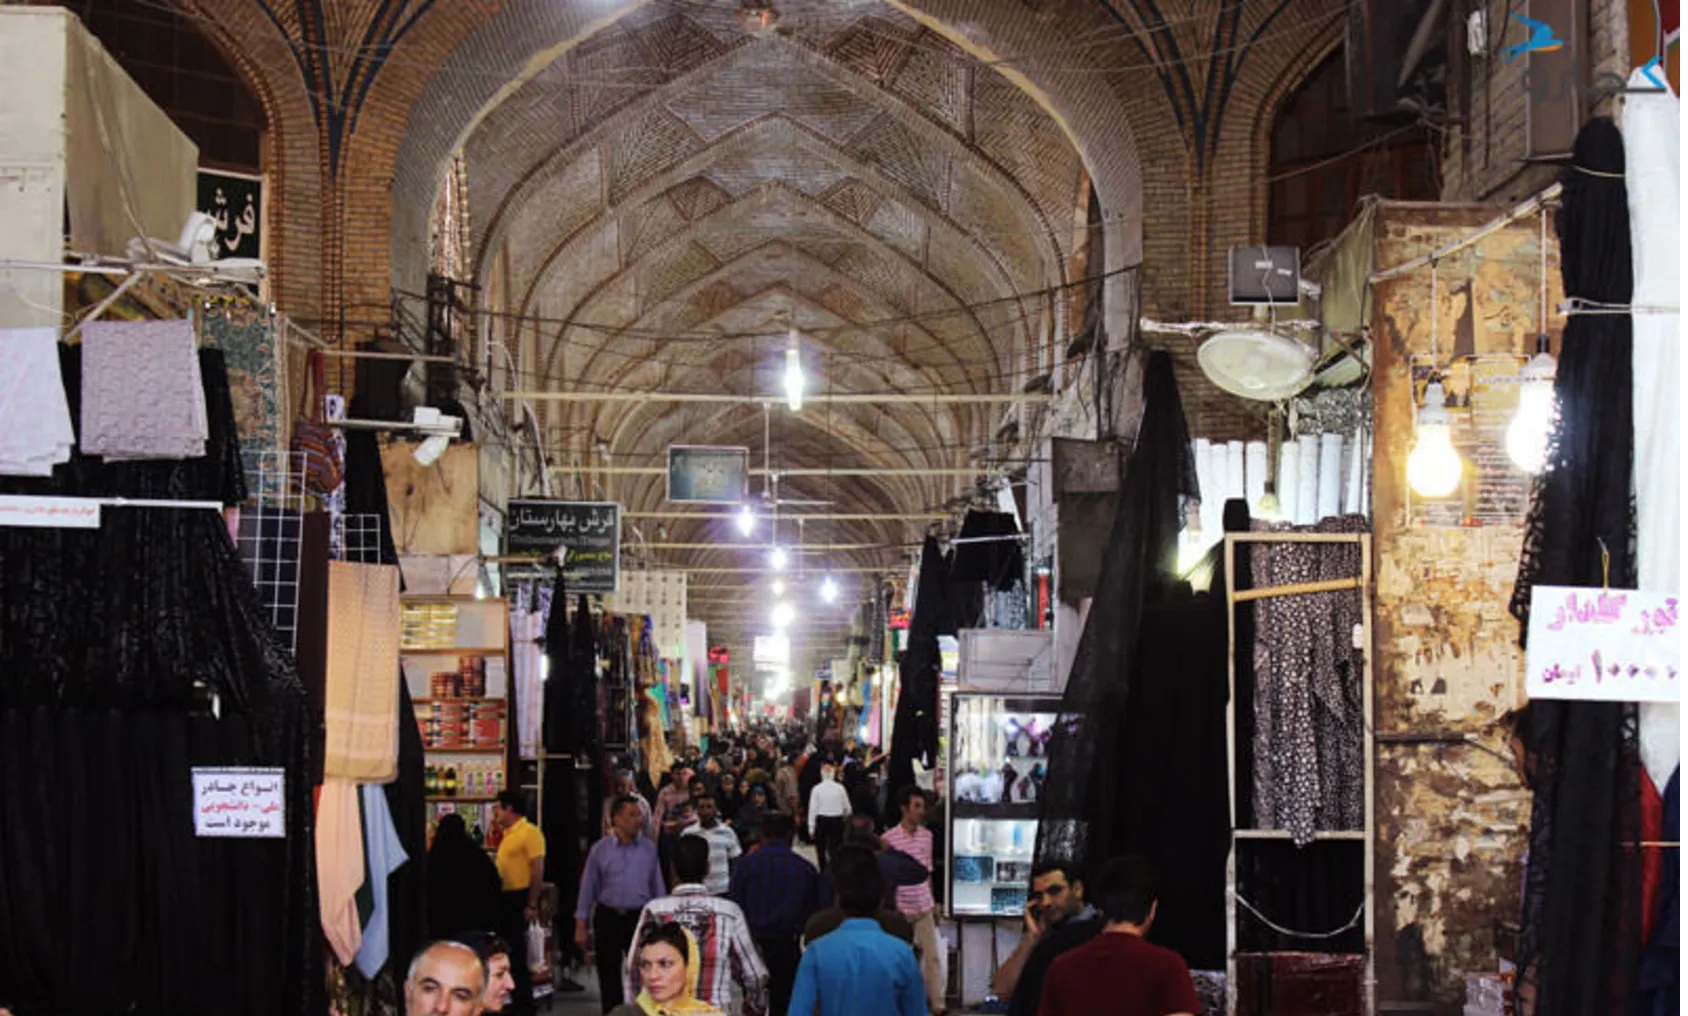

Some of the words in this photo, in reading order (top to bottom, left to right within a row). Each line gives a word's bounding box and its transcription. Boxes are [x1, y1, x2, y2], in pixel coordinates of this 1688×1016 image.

[508, 508, 577, 533] بهارستان
[578, 507, 614, 534] فرش
[201, 779, 237, 796] چادر
[240, 780, 278, 796] انواع
[205, 815, 232, 828] است
[233, 818, 270, 832] موجود
